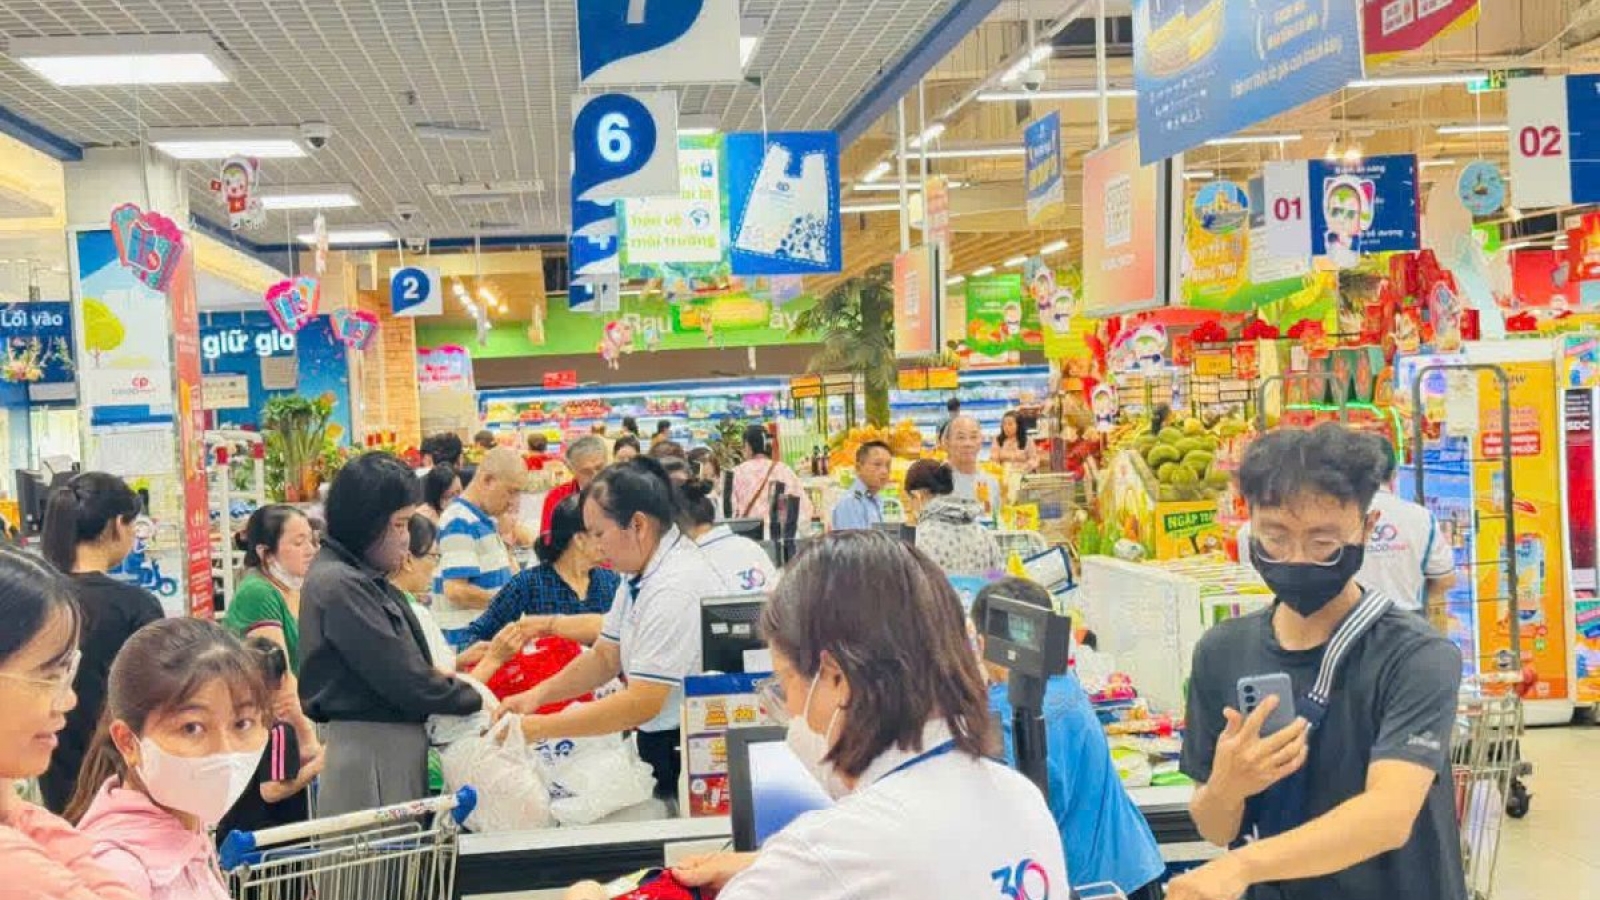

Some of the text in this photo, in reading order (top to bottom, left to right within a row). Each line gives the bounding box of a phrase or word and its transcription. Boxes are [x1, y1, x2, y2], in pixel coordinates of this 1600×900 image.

[596, 112, 632, 163] 6
[1519, 125, 1562, 158] 02
[1273, 197, 1302, 221] 01
[402, 276, 420, 299] 2
[990, 858, 1049, 900] 30
